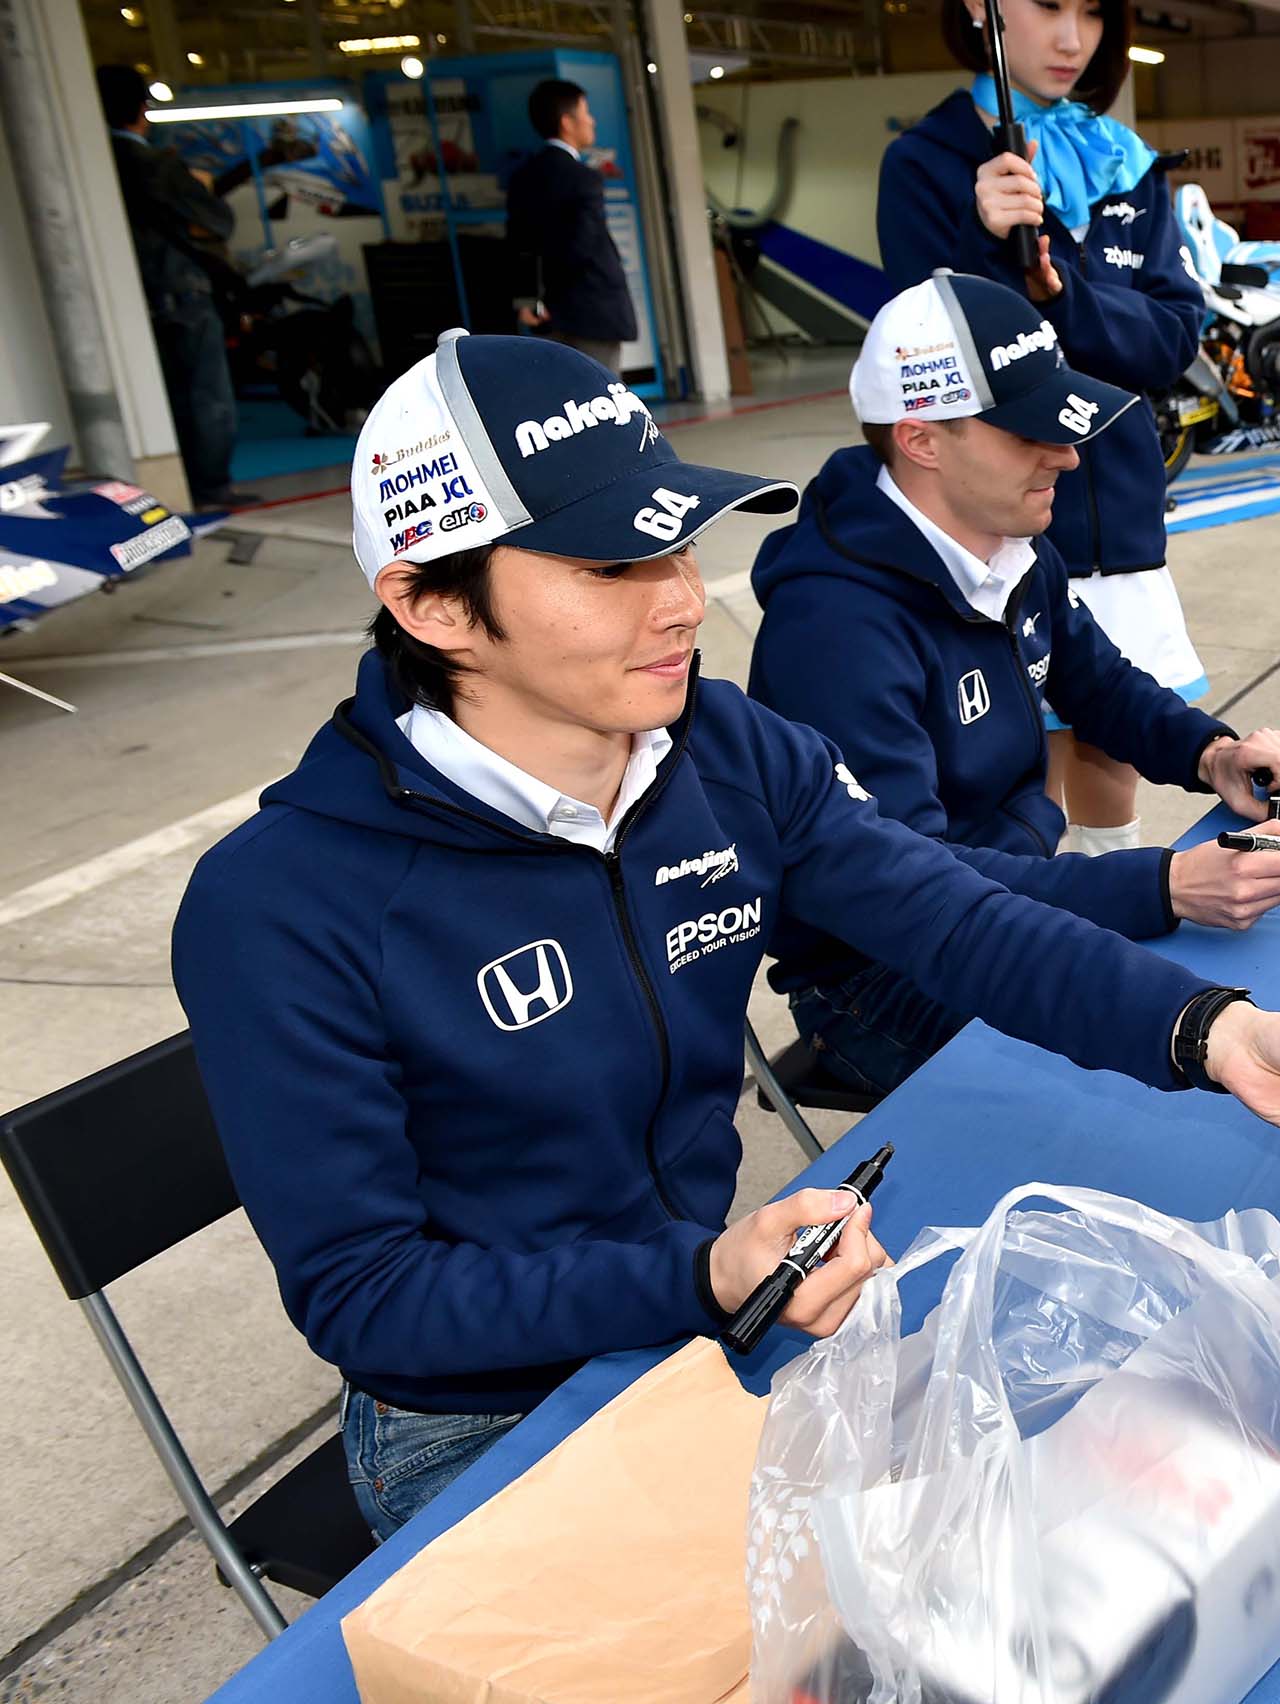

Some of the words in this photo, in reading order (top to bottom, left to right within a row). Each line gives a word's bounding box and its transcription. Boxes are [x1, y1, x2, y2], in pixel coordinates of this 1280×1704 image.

[902, 379, 940, 394] PIAA
[1058, 393, 1100, 436] 64
[384, 493, 437, 528] PIAA
[633, 486, 701, 542] 64
[666, 896, 761, 962] EPSON
[669, 950, 700, 975] EXCEED
[701, 938, 727, 956] YOUR
[729, 925, 761, 945] VISION
